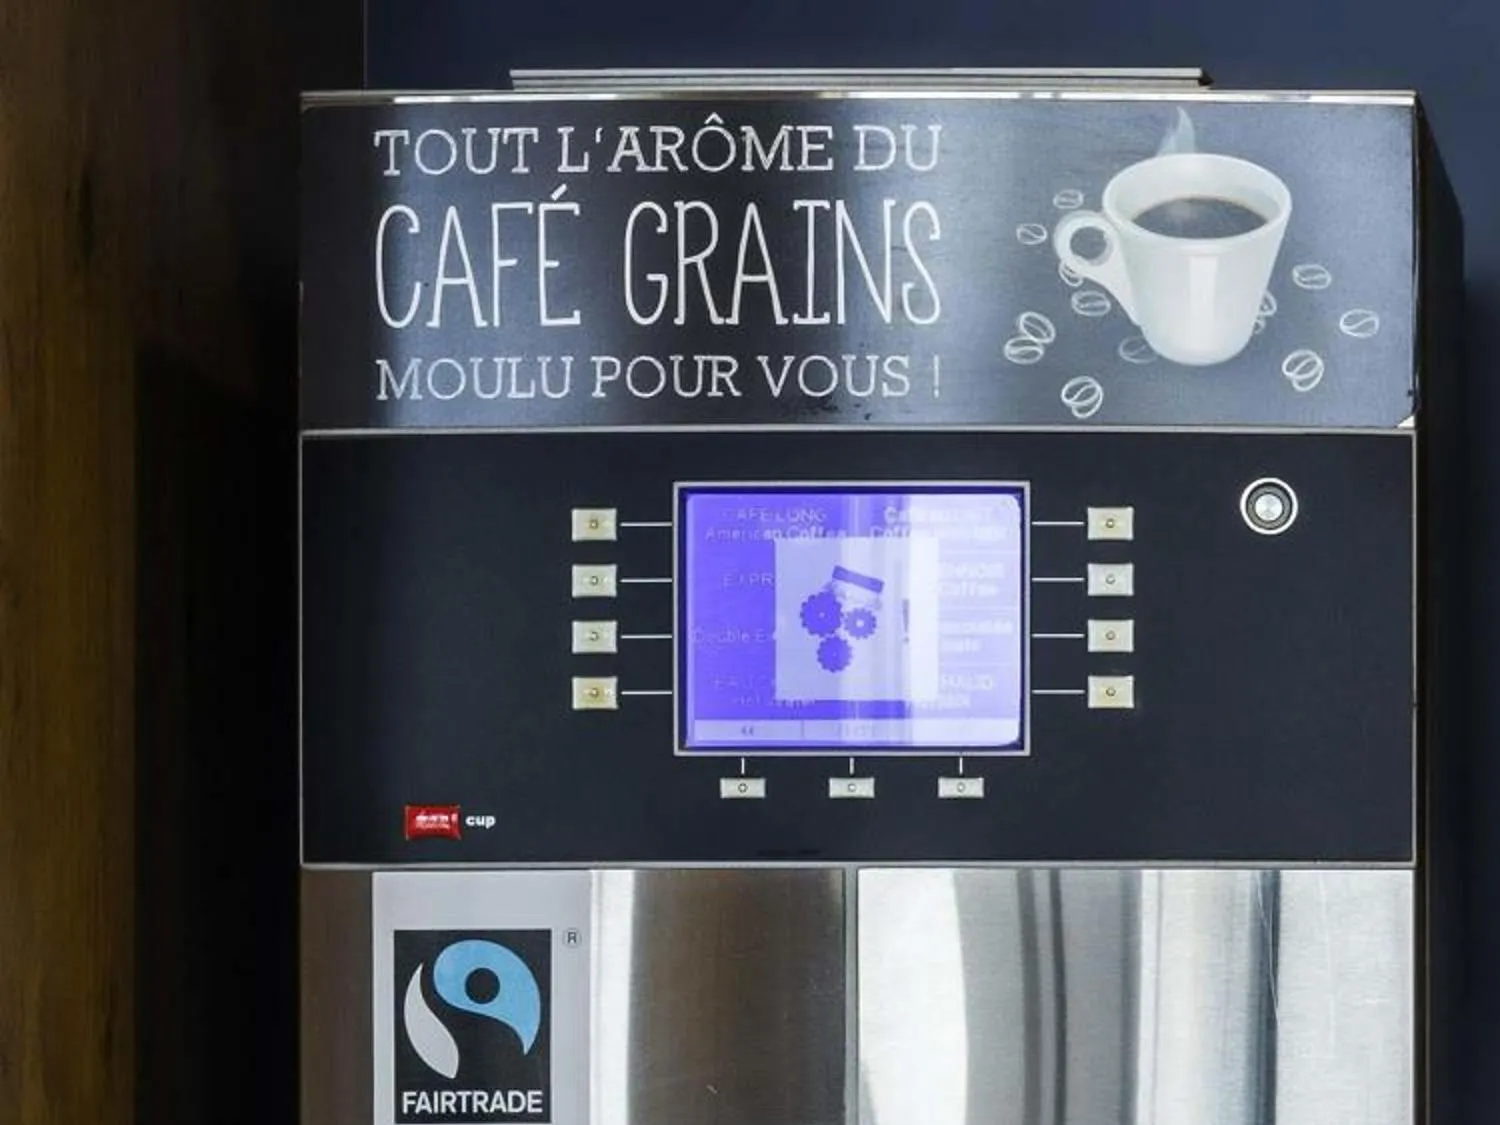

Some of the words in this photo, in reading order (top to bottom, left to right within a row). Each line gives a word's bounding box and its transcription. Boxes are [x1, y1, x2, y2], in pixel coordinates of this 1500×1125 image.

[373, 128, 539, 177] TOUT
[557, 112, 834, 174] L'ARÔME
[853, 124, 943, 172] DU
[374, 184, 581, 328] CAFÉ
[623, 199, 942, 326] GRAINS
[376, 355, 574, 400] MOULU
[590, 354, 742, 398] POUR
[757, 354, 911, 398] VOUS
[465, 813, 496, 829] cup
[402, 1090, 543, 1114] FAIRTRADE
